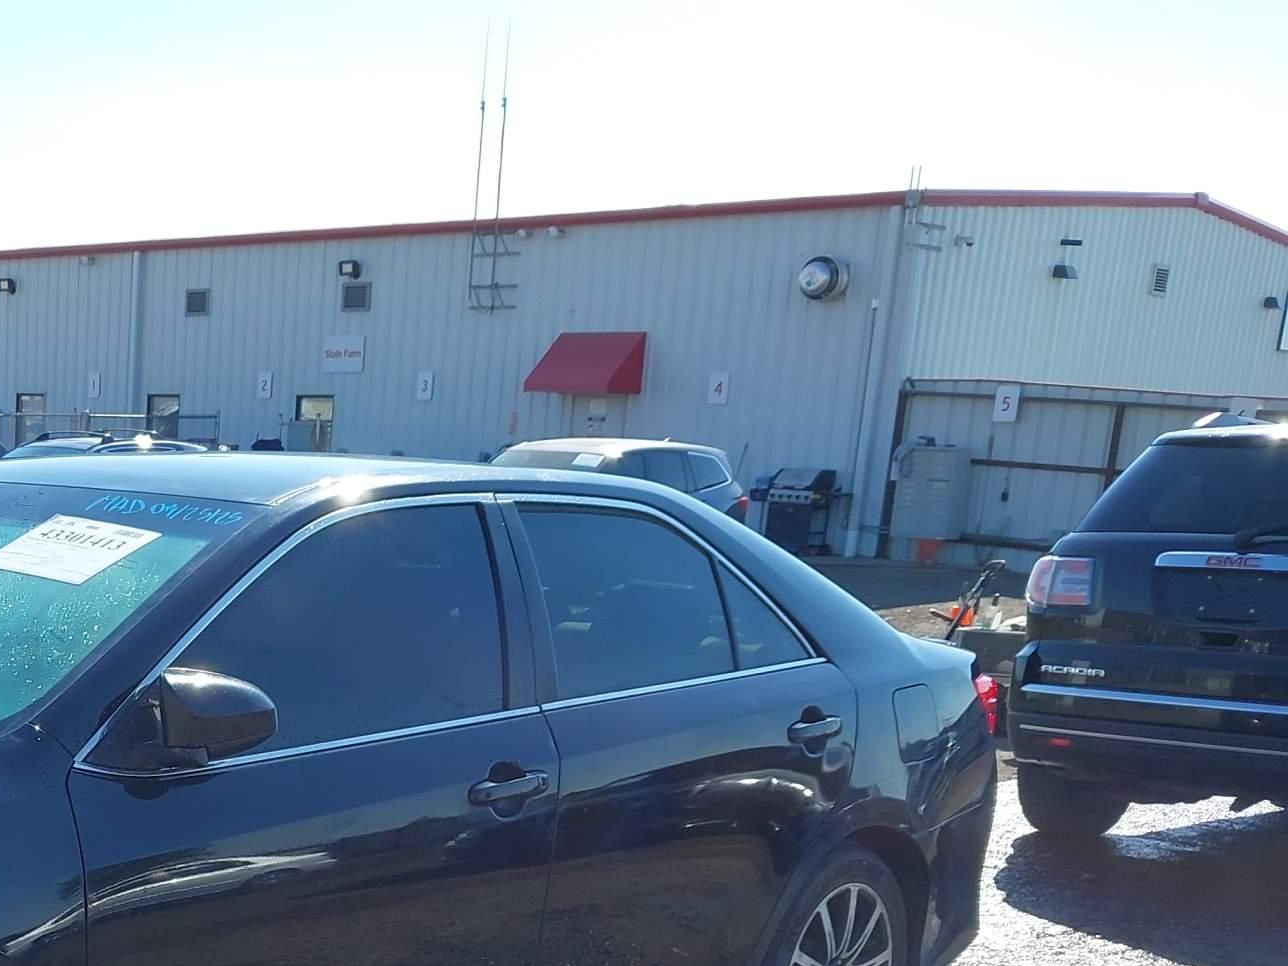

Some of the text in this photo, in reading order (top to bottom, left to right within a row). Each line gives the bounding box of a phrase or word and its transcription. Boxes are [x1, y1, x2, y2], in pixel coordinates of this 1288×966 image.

[343, 349, 362, 359] Farm
[714, 381, 723, 396] 4
[1001, 396, 1011, 412] 5
[40, 528, 127, 551] 43301413
[1206, 554, 1262, 568] GMC
[1040, 664, 1106, 678] ACADIA
